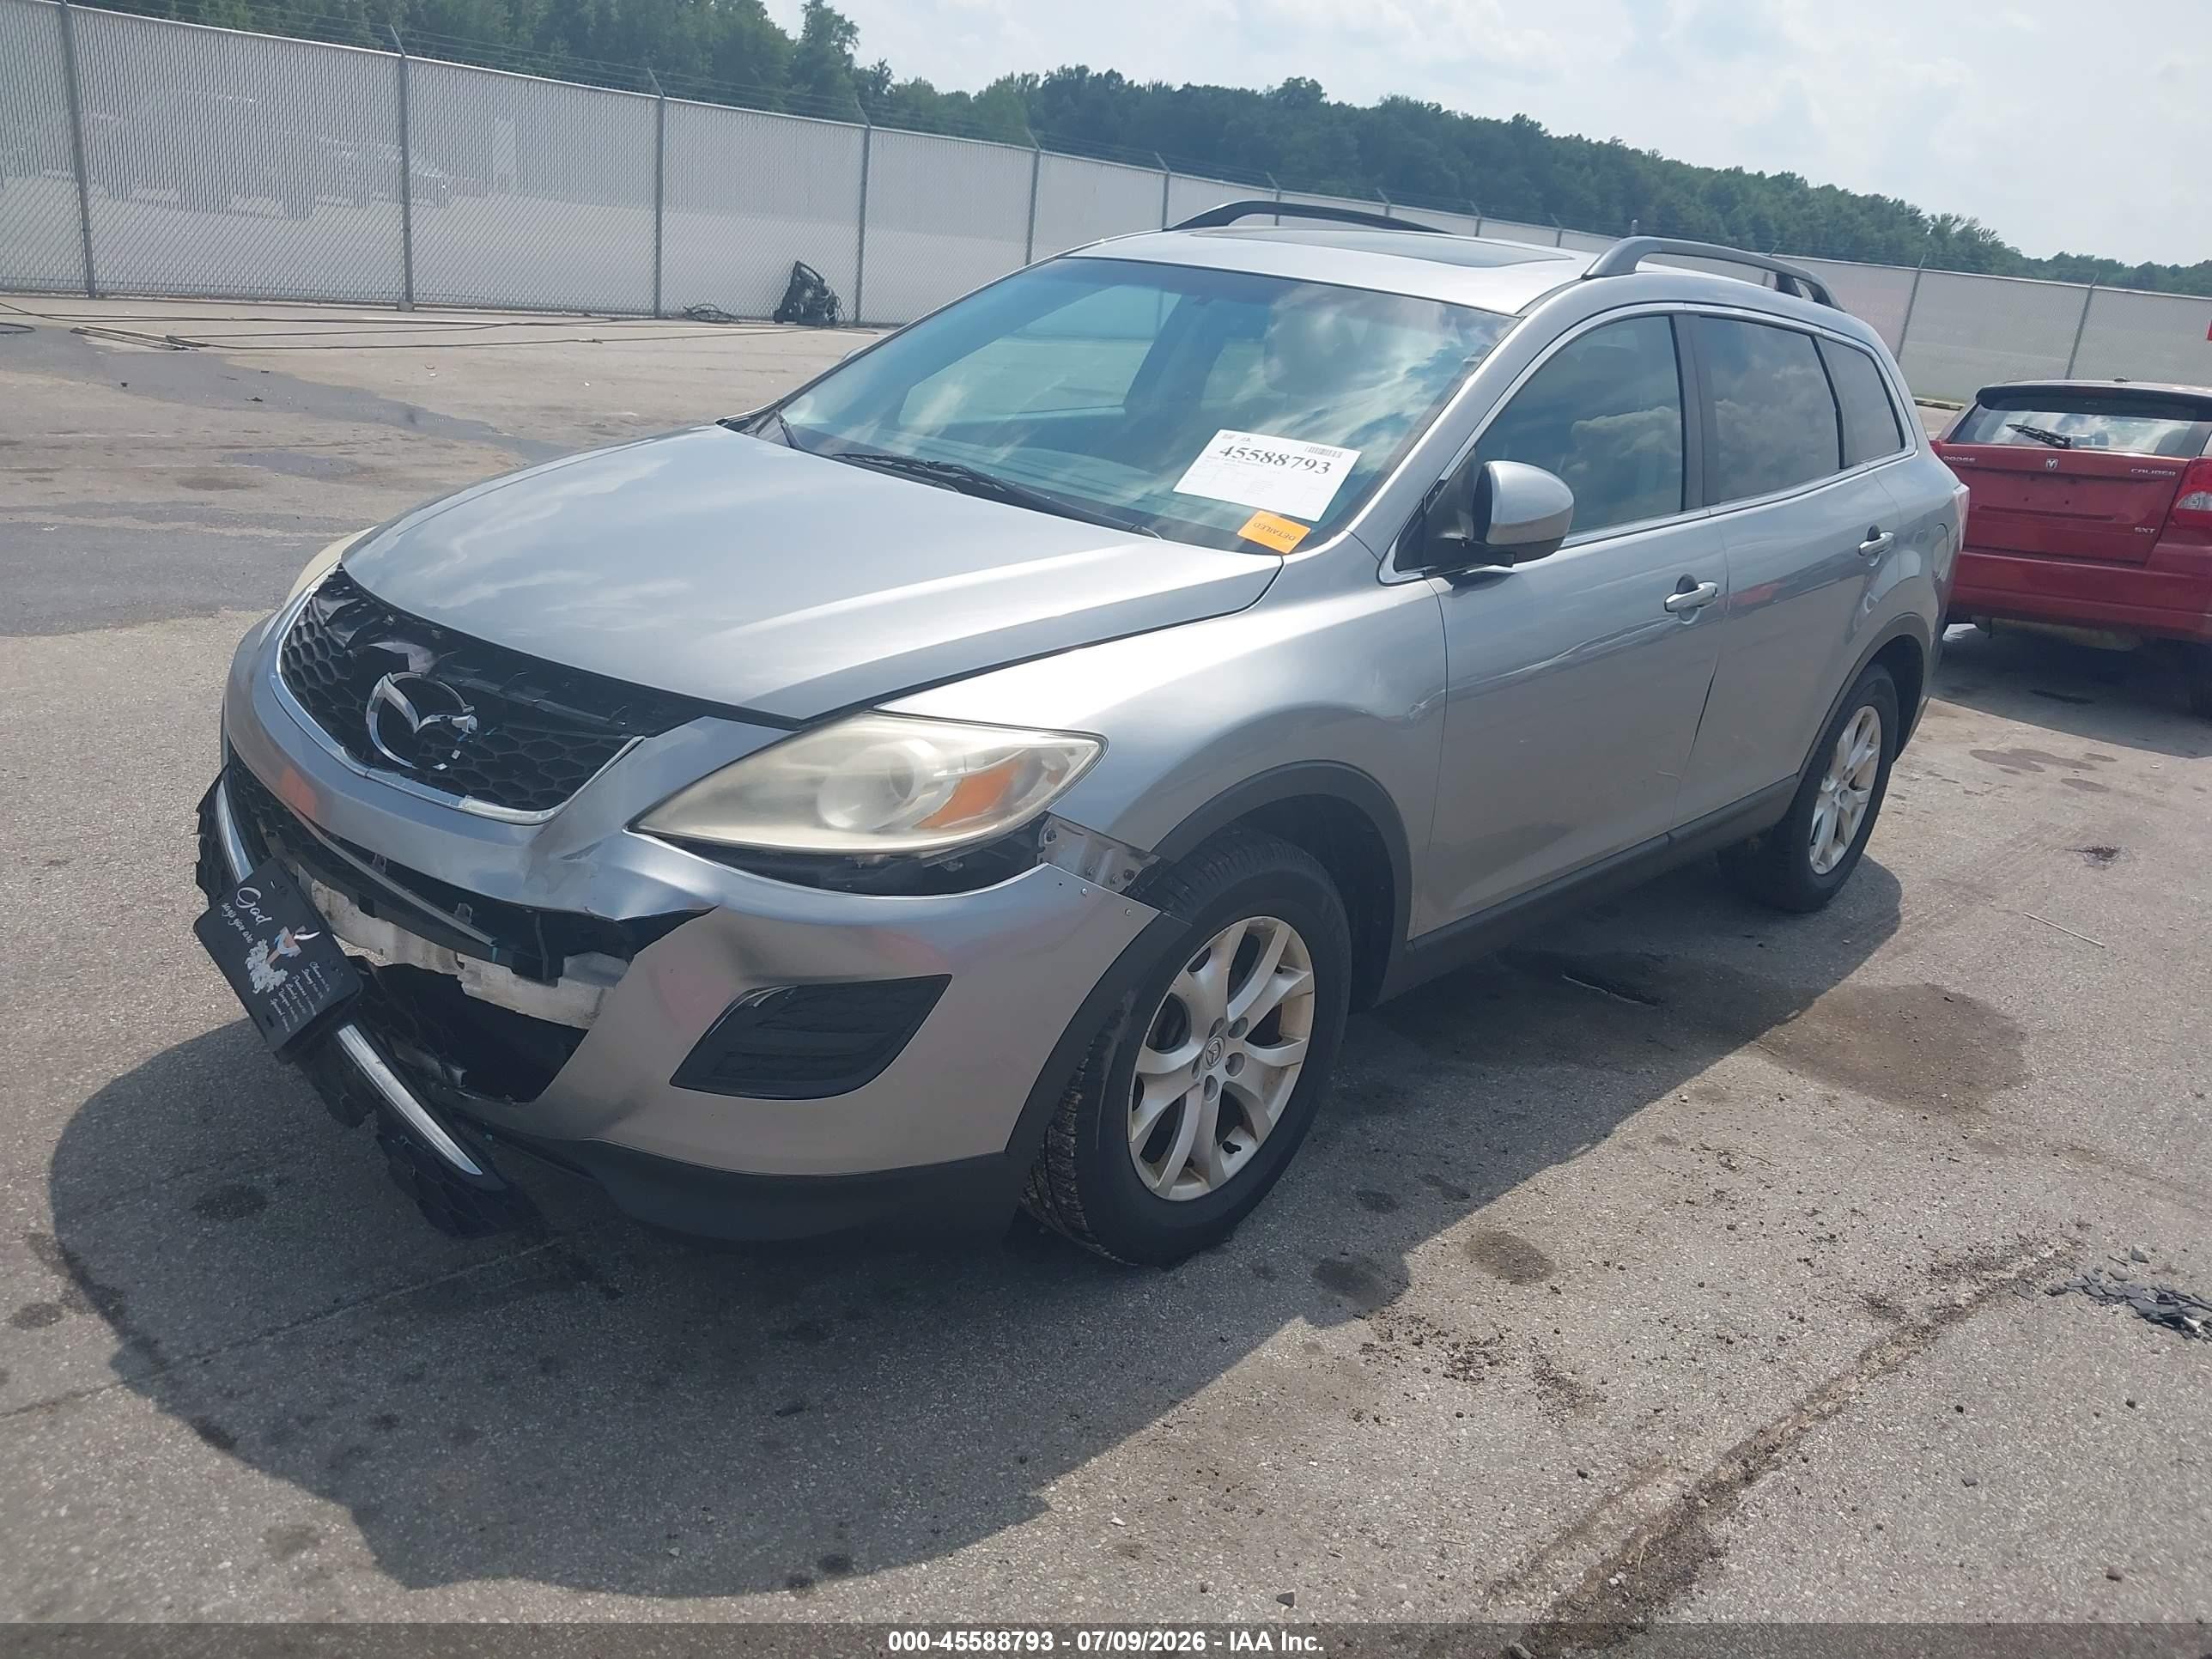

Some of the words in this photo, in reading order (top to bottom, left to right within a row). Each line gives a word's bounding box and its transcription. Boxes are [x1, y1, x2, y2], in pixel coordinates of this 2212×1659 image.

[1219, 441, 1332, 475] 45588793
[2130, 468, 2177, 477] CALIBER
[1254, 522, 1297, 541] DETAILED
[235, 886, 272, 926] God
[227, 918, 246, 932] you
[242, 931, 254, 944] are
